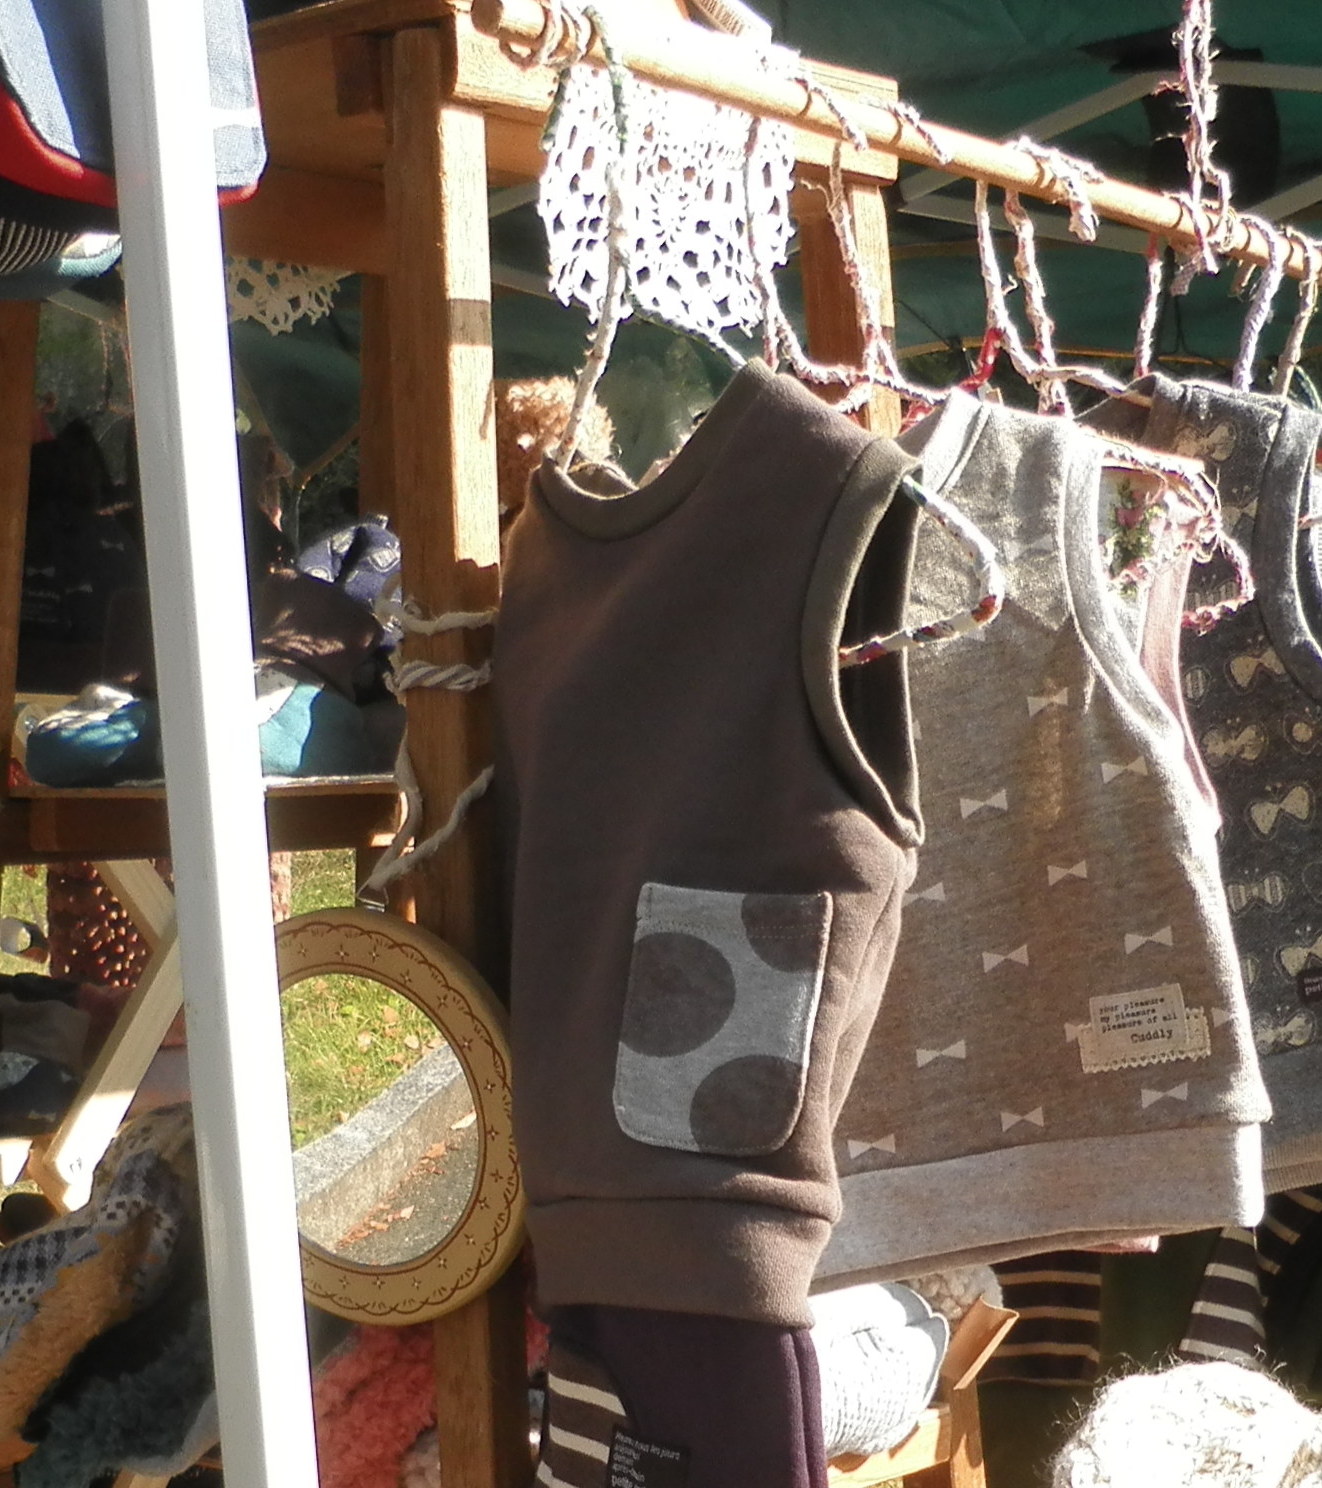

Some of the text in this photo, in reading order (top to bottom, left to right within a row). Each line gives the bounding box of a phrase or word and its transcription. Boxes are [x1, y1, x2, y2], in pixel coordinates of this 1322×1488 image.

[1123, 996, 1166, 1012] pleasure
[1100, 1008, 1157, 1024] my pleasure
[1101, 1012, 1178, 1034] pleasure of all
[1130, 1028, 1174, 1044] Cuddly
